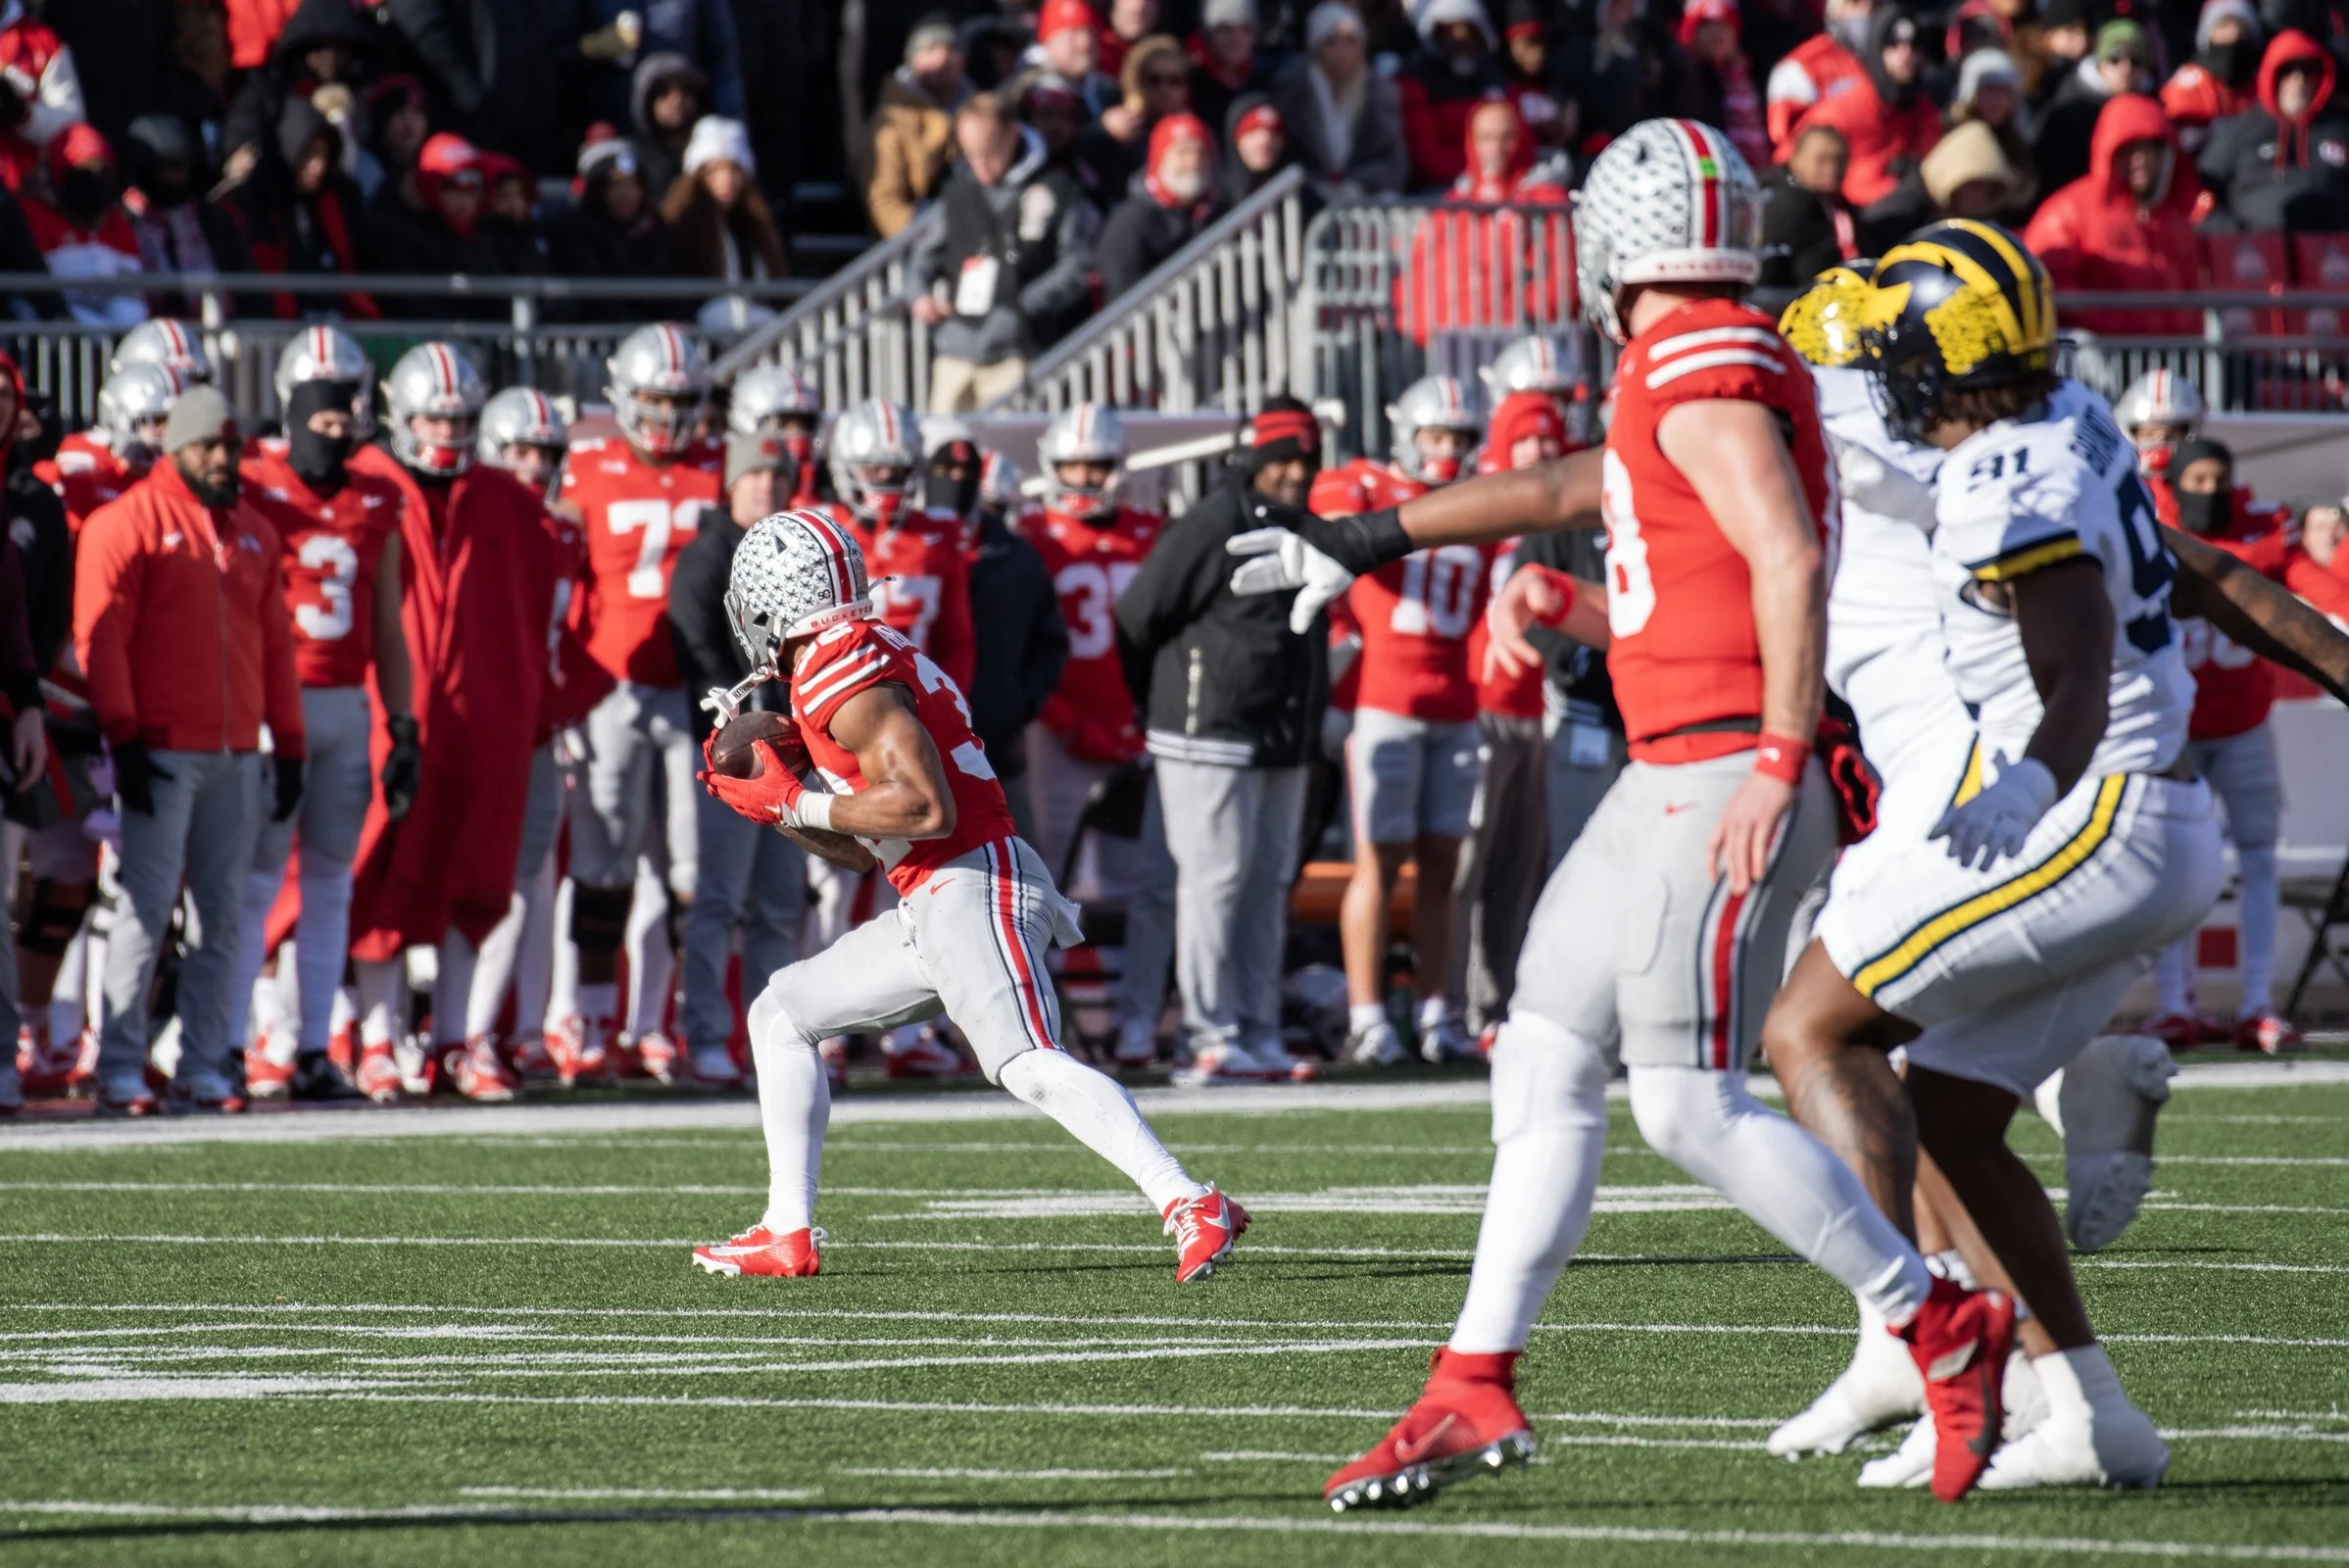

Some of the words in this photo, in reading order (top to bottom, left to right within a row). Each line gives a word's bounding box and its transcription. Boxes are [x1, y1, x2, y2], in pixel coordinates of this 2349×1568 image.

[297, 534, 358, 640] 3
[1053, 562, 1140, 658] 3
[1392, 545, 1483, 638] 10
